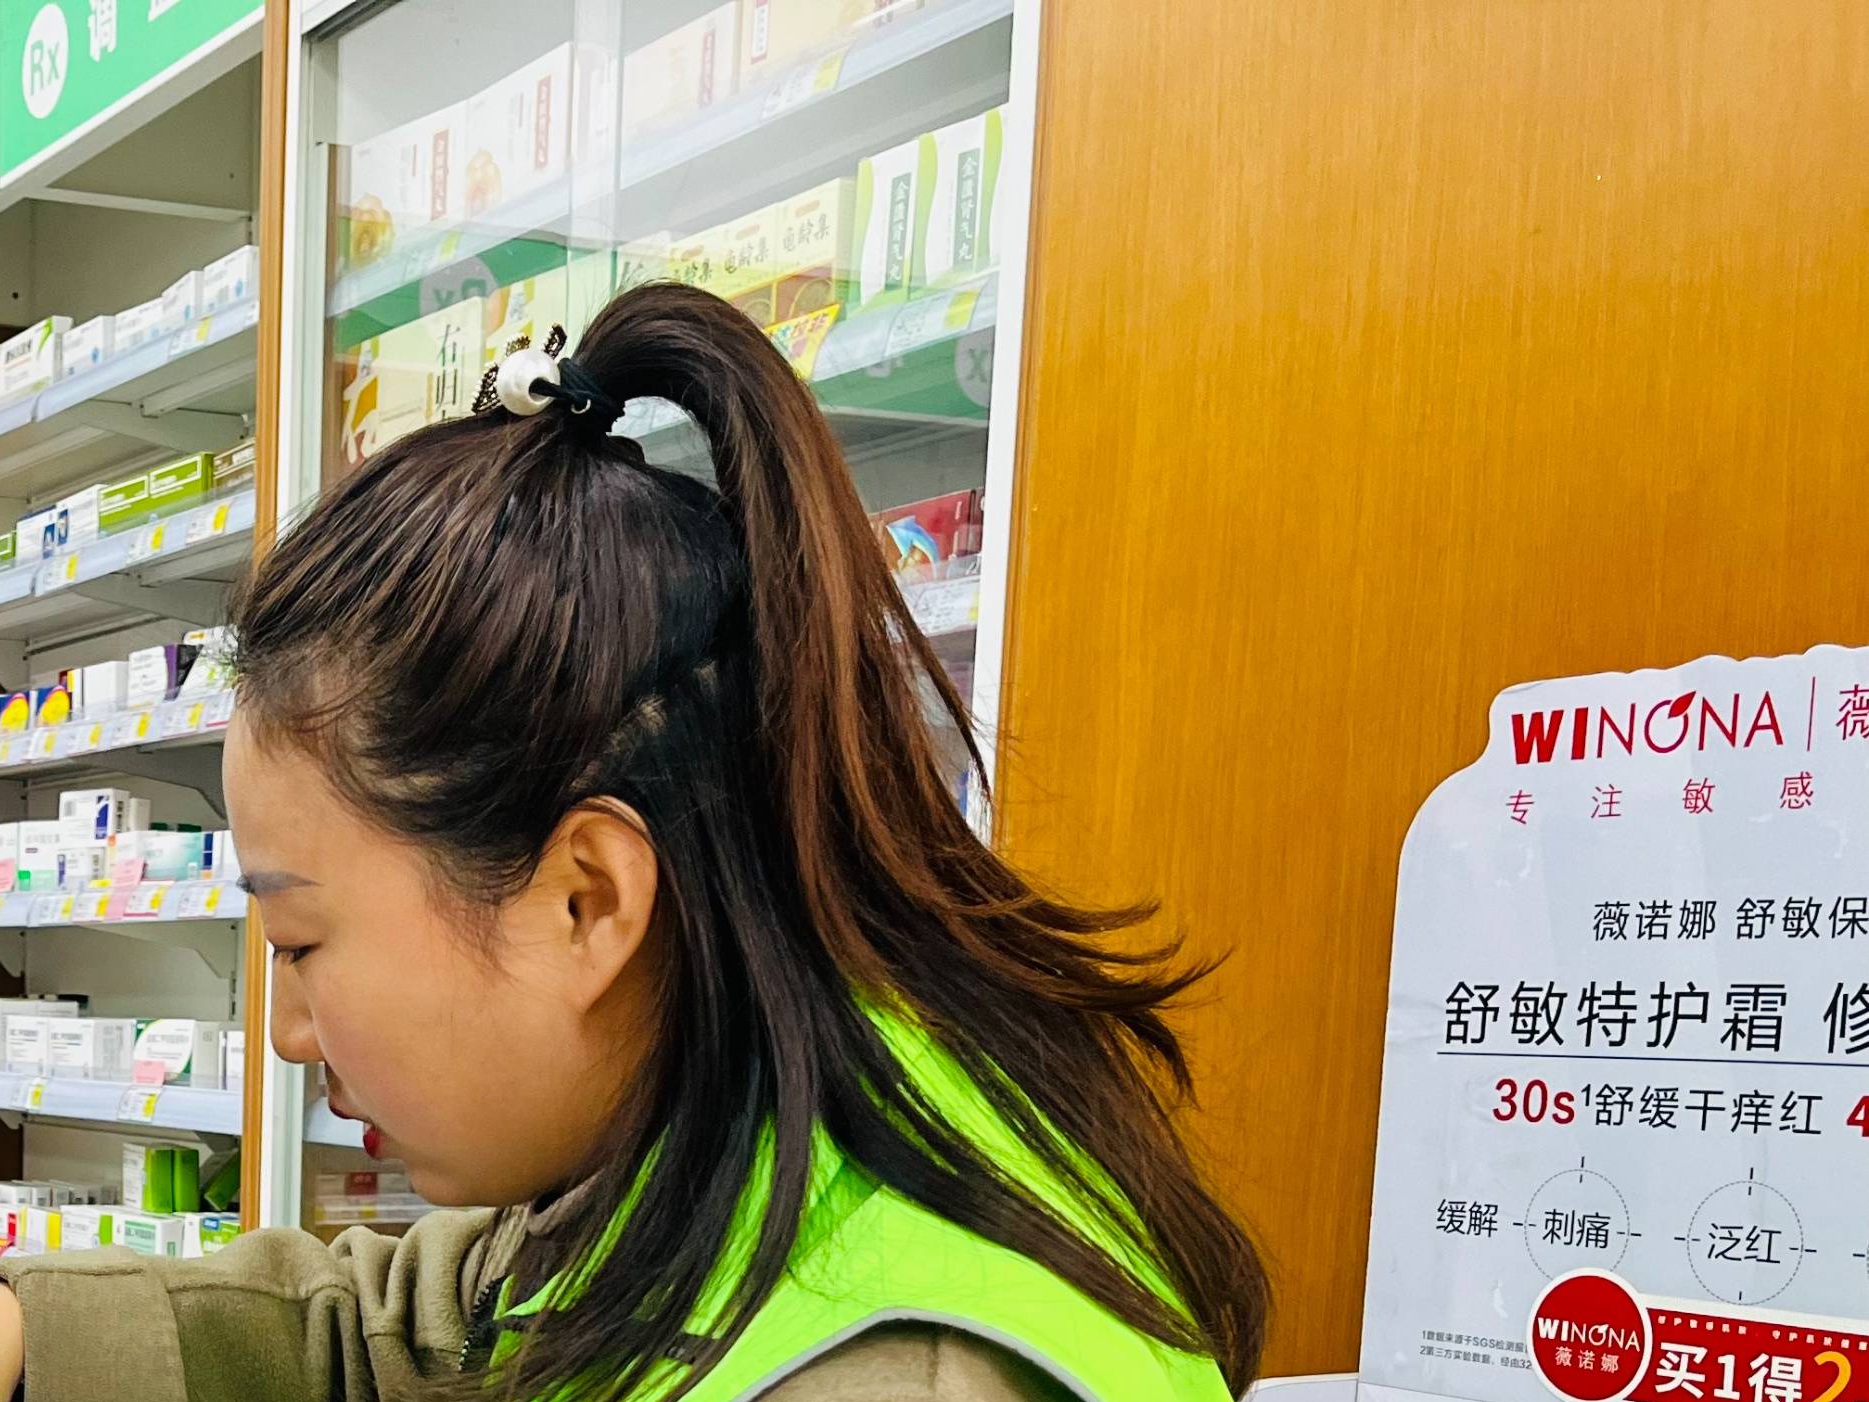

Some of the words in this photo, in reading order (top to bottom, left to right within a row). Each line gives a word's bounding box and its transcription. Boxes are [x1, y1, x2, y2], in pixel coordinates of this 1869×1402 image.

[31, 40, 61, 94] Rx
[1512, 691, 1783, 764] WINONA
[1506, 771, 1814, 825] 专注敏感
[1593, 900, 1717, 942] 薇诺娜
[1445, 981, 1788, 1053] 舒敏特护霜
[1436, 1199, 1499, 1238] 缓解
[1542, 1209, 1611, 1249] 刺痛
[1707, 1222, 1783, 1264] 泛红
[1538, 1317, 1641, 1353] WINONA
[1554, 1346, 1620, 1374] 薇诺娜
